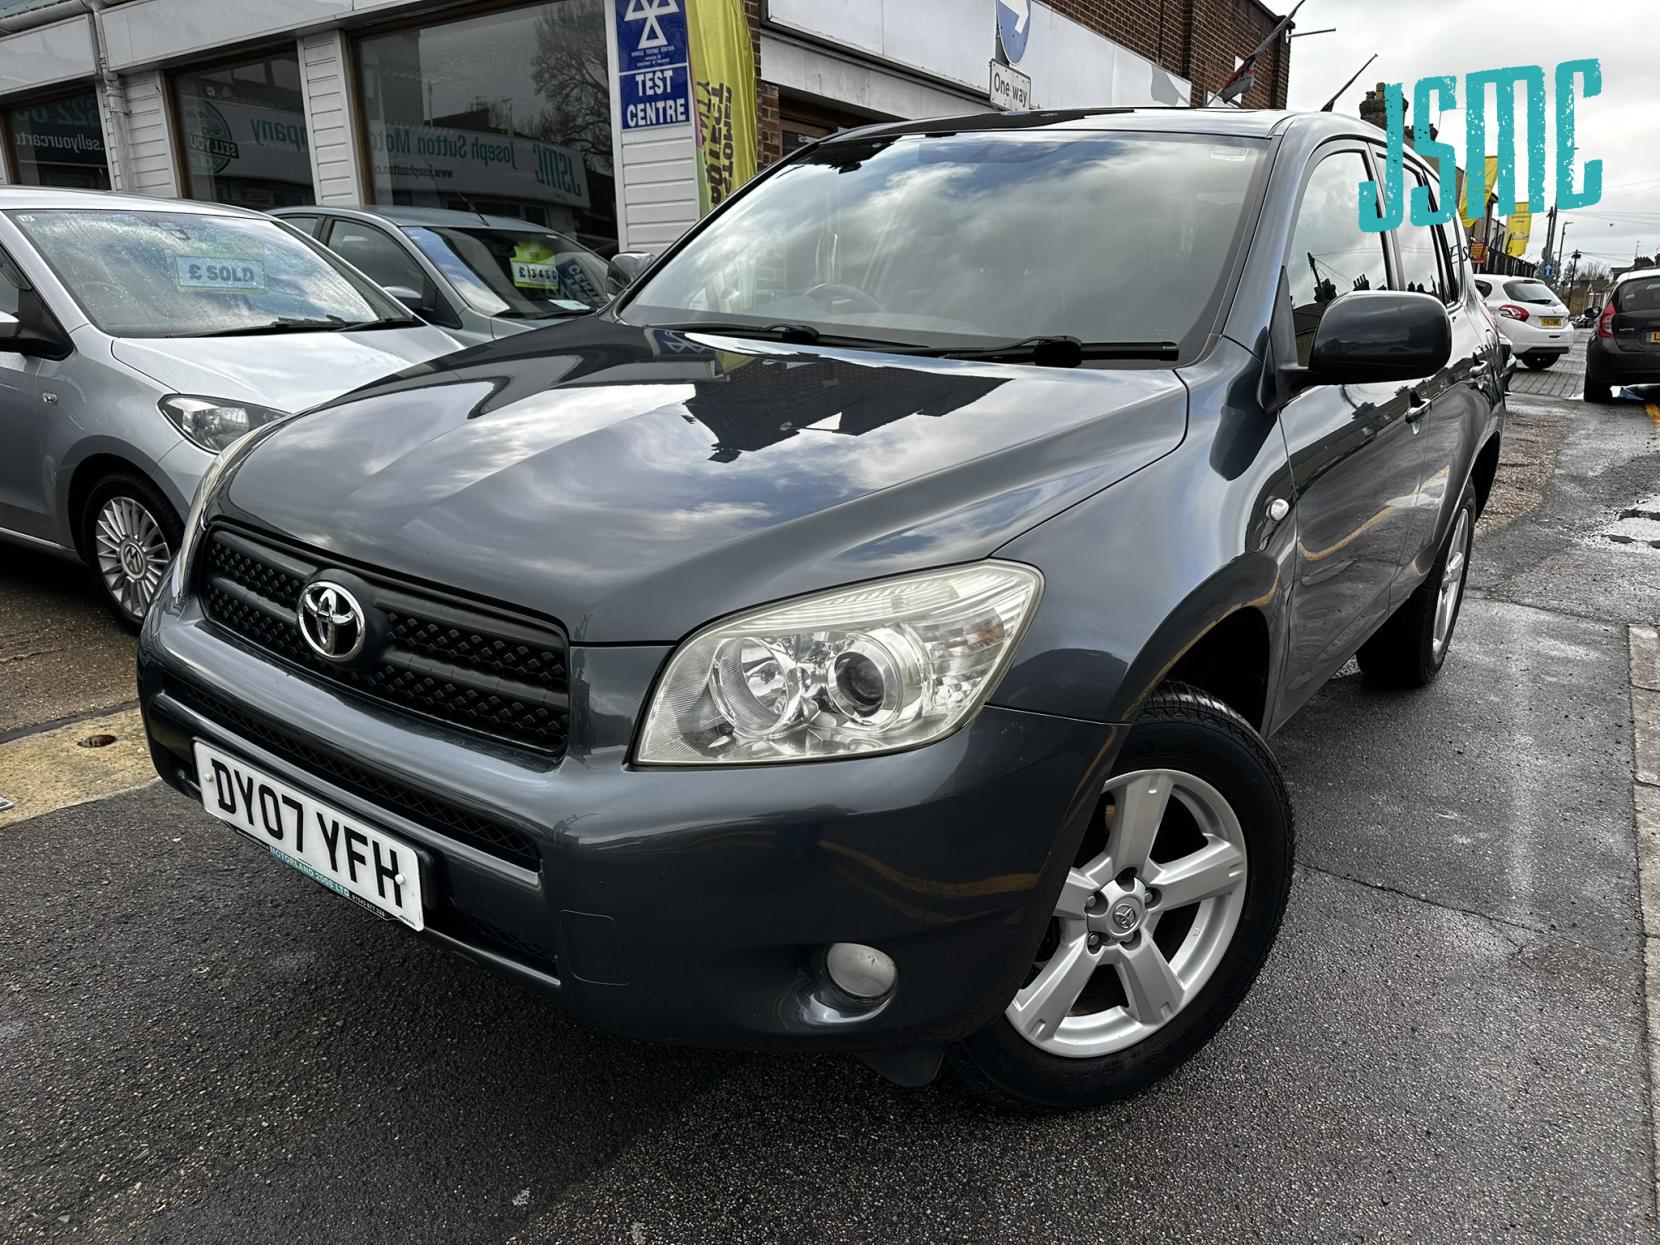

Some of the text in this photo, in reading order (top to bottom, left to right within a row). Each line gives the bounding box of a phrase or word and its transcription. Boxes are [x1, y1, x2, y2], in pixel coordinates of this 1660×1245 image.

[635, 69, 673, 97] TEST
[994, 72, 1028, 108] One way
[627, 98, 687, 127] CENTRE
[206, 264, 255, 282] SOLD
[211, 758, 403, 909] DY07 YFH
[334, 884, 350, 898] LTD
